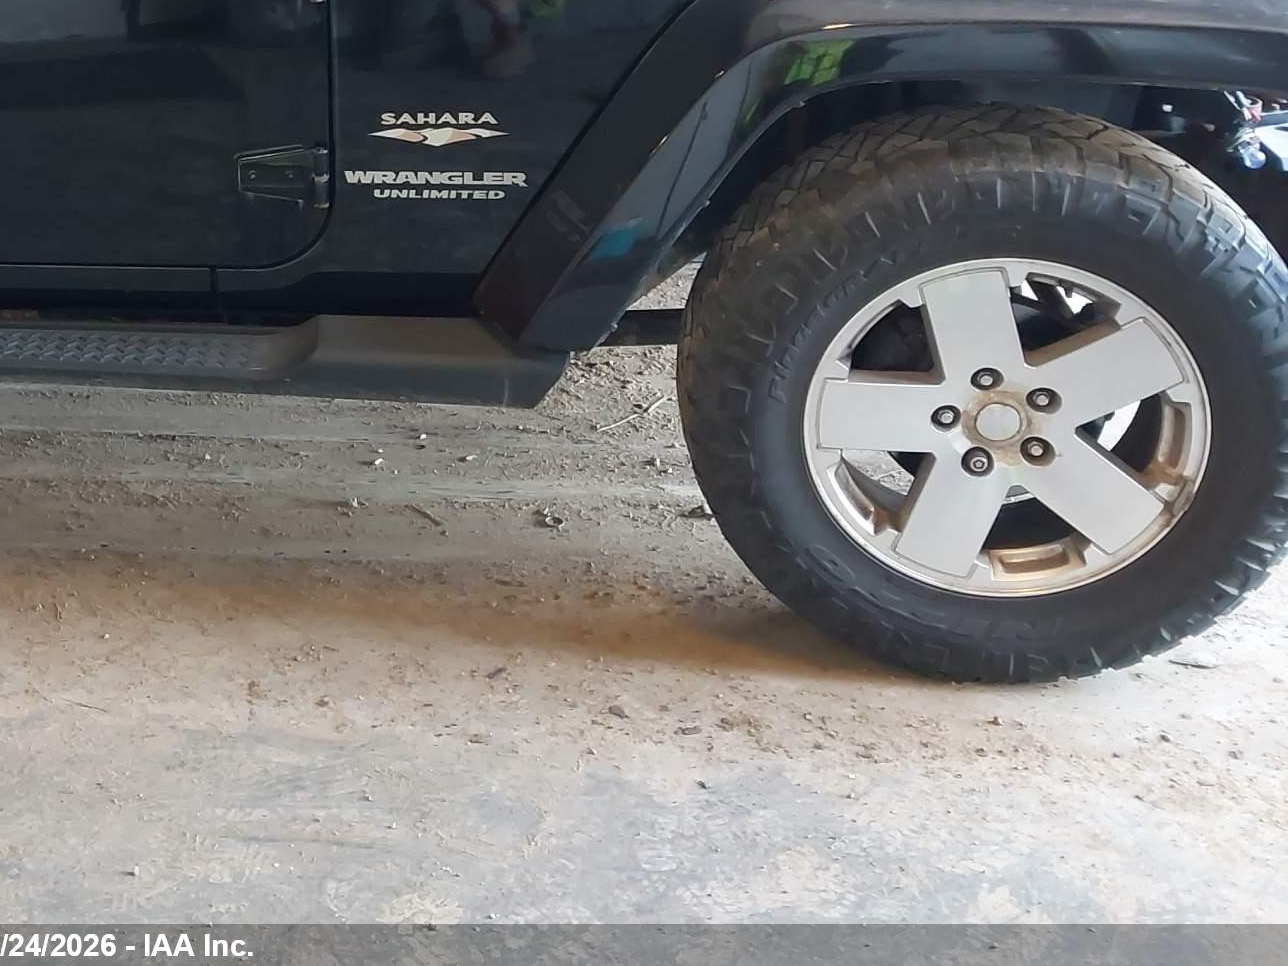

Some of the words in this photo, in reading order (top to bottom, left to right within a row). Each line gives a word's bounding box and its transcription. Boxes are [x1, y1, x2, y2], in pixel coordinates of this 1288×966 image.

[380, 112, 499, 125] SAHARA
[343, 170, 528, 187] WRANGLER
[373, 189, 506, 200] UNLIMITED
